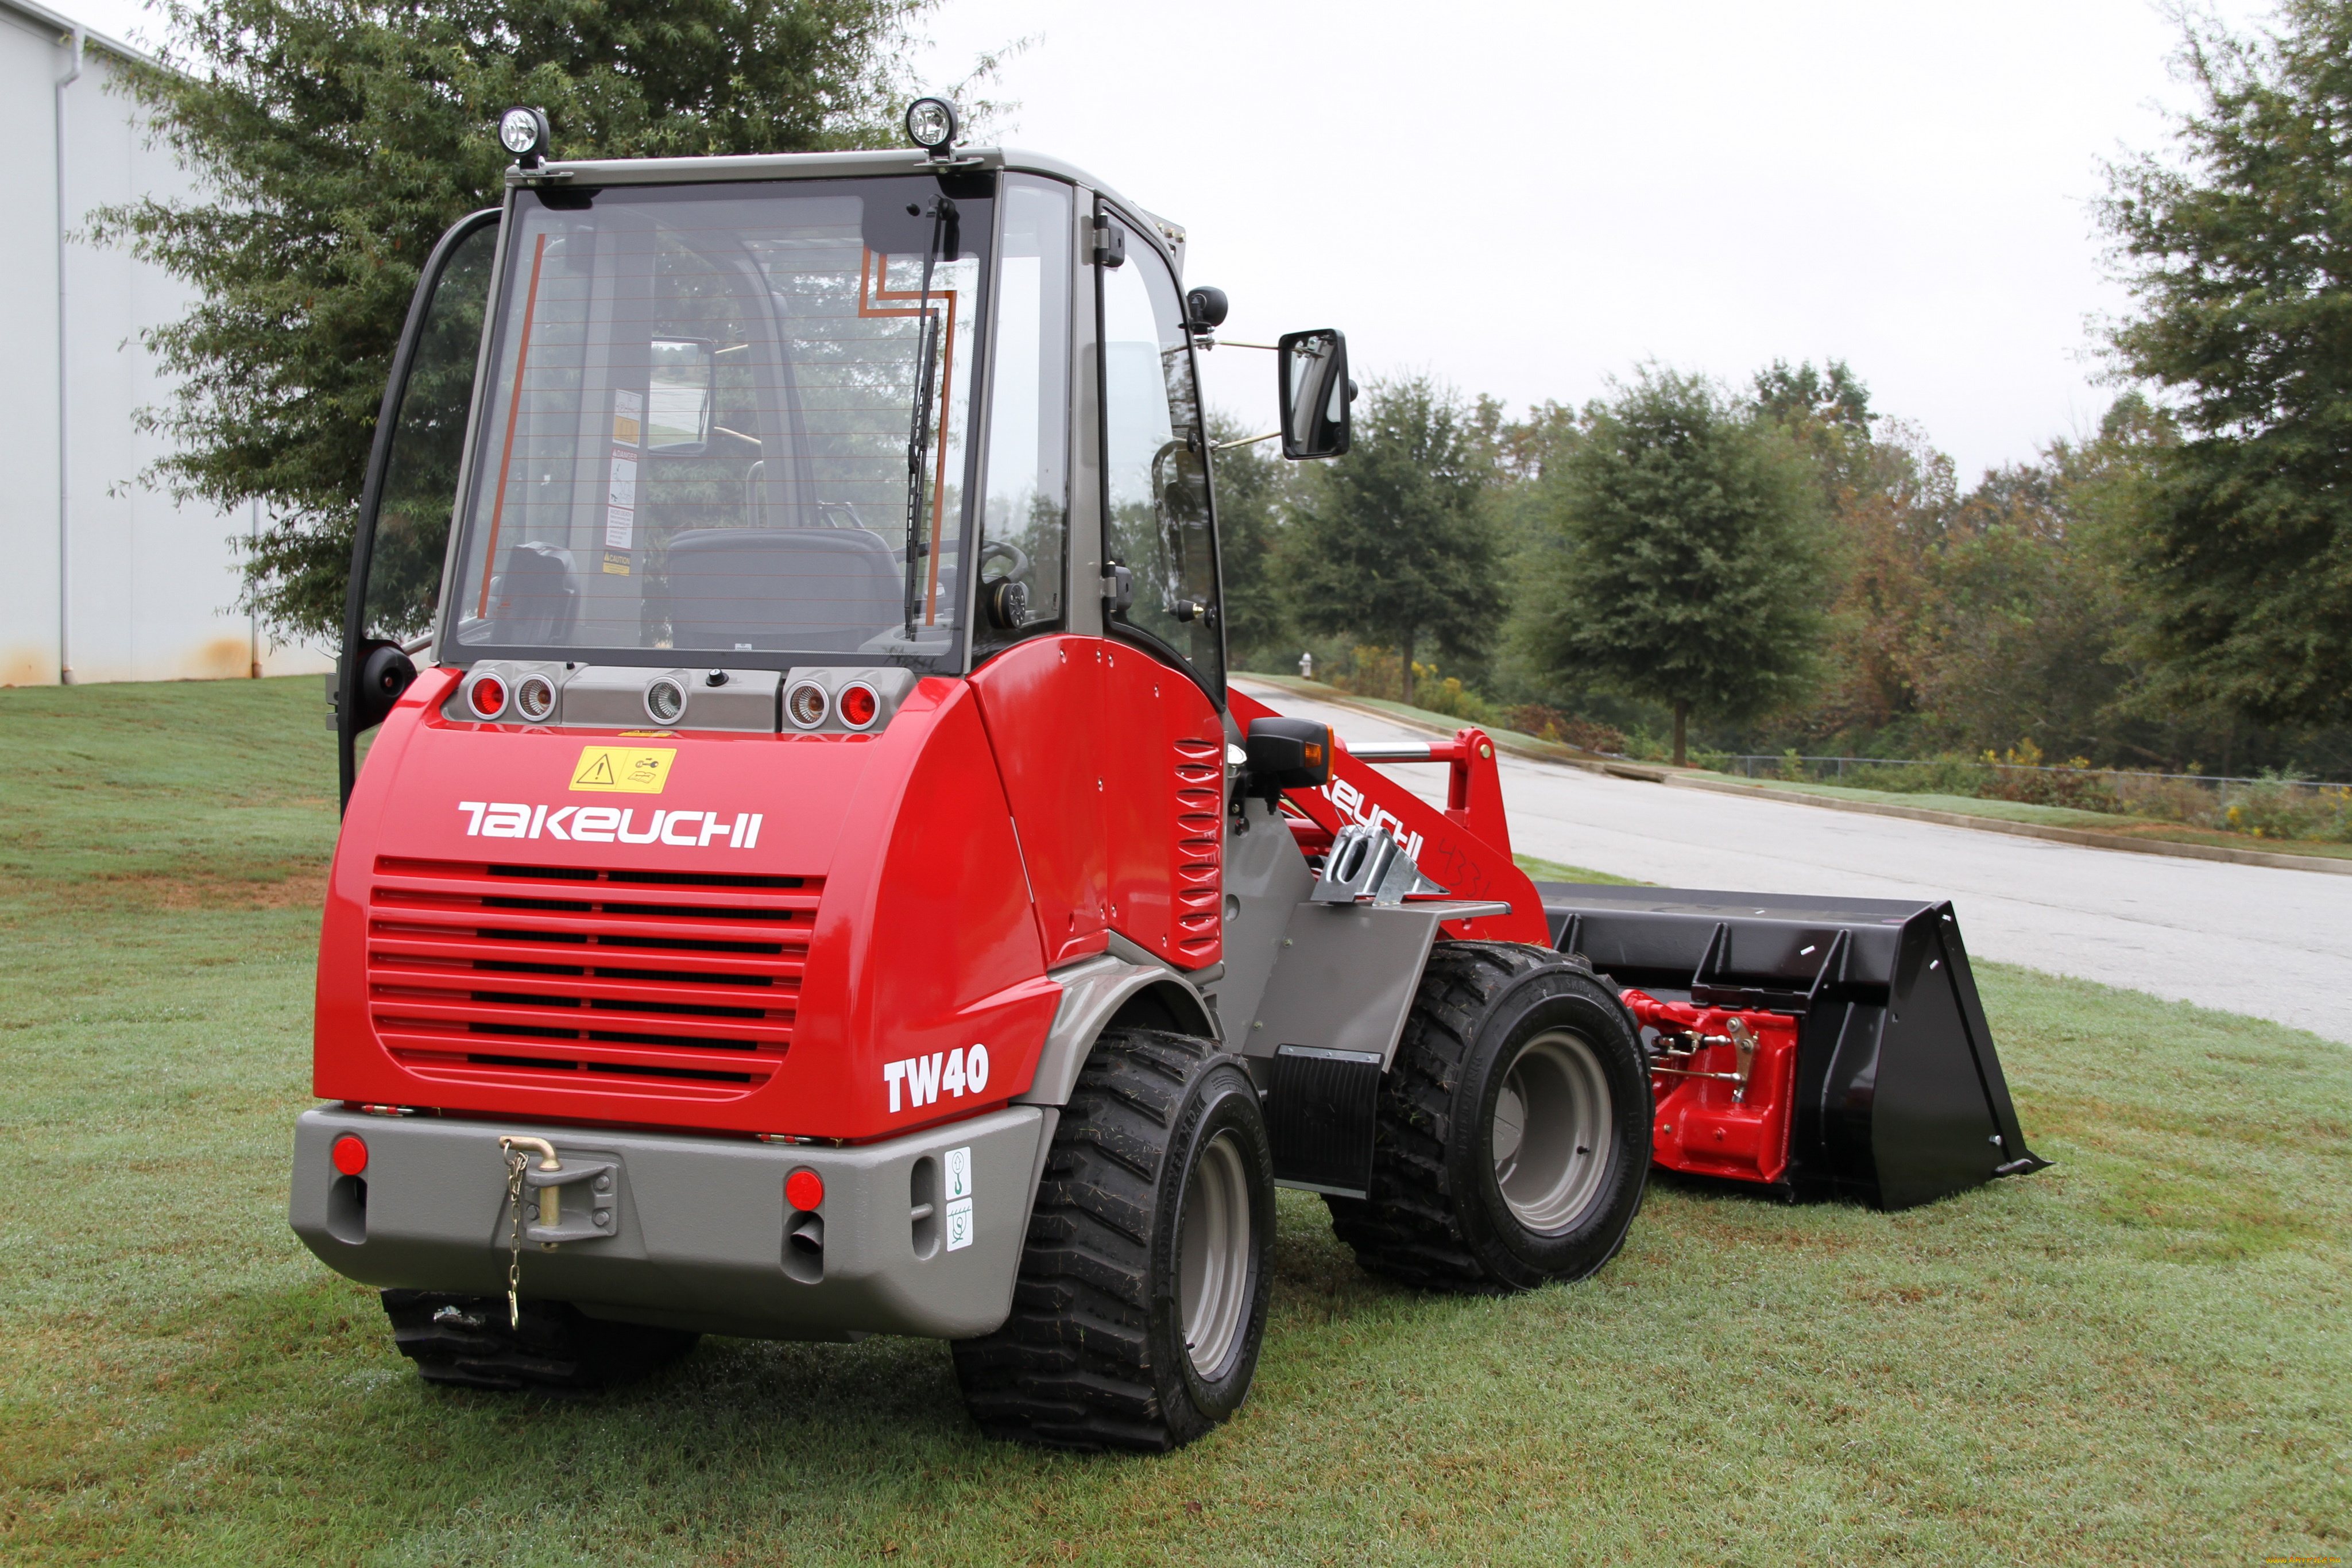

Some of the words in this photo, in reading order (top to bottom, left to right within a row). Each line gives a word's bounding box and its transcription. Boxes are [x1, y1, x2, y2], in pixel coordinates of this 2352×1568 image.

[617, 450, 637, 462] DANGER
[610, 555, 630, 564] CAUTION
[458, 801, 763, 849] TAKEUCHI
[883, 1043, 989, 1113] TW40
